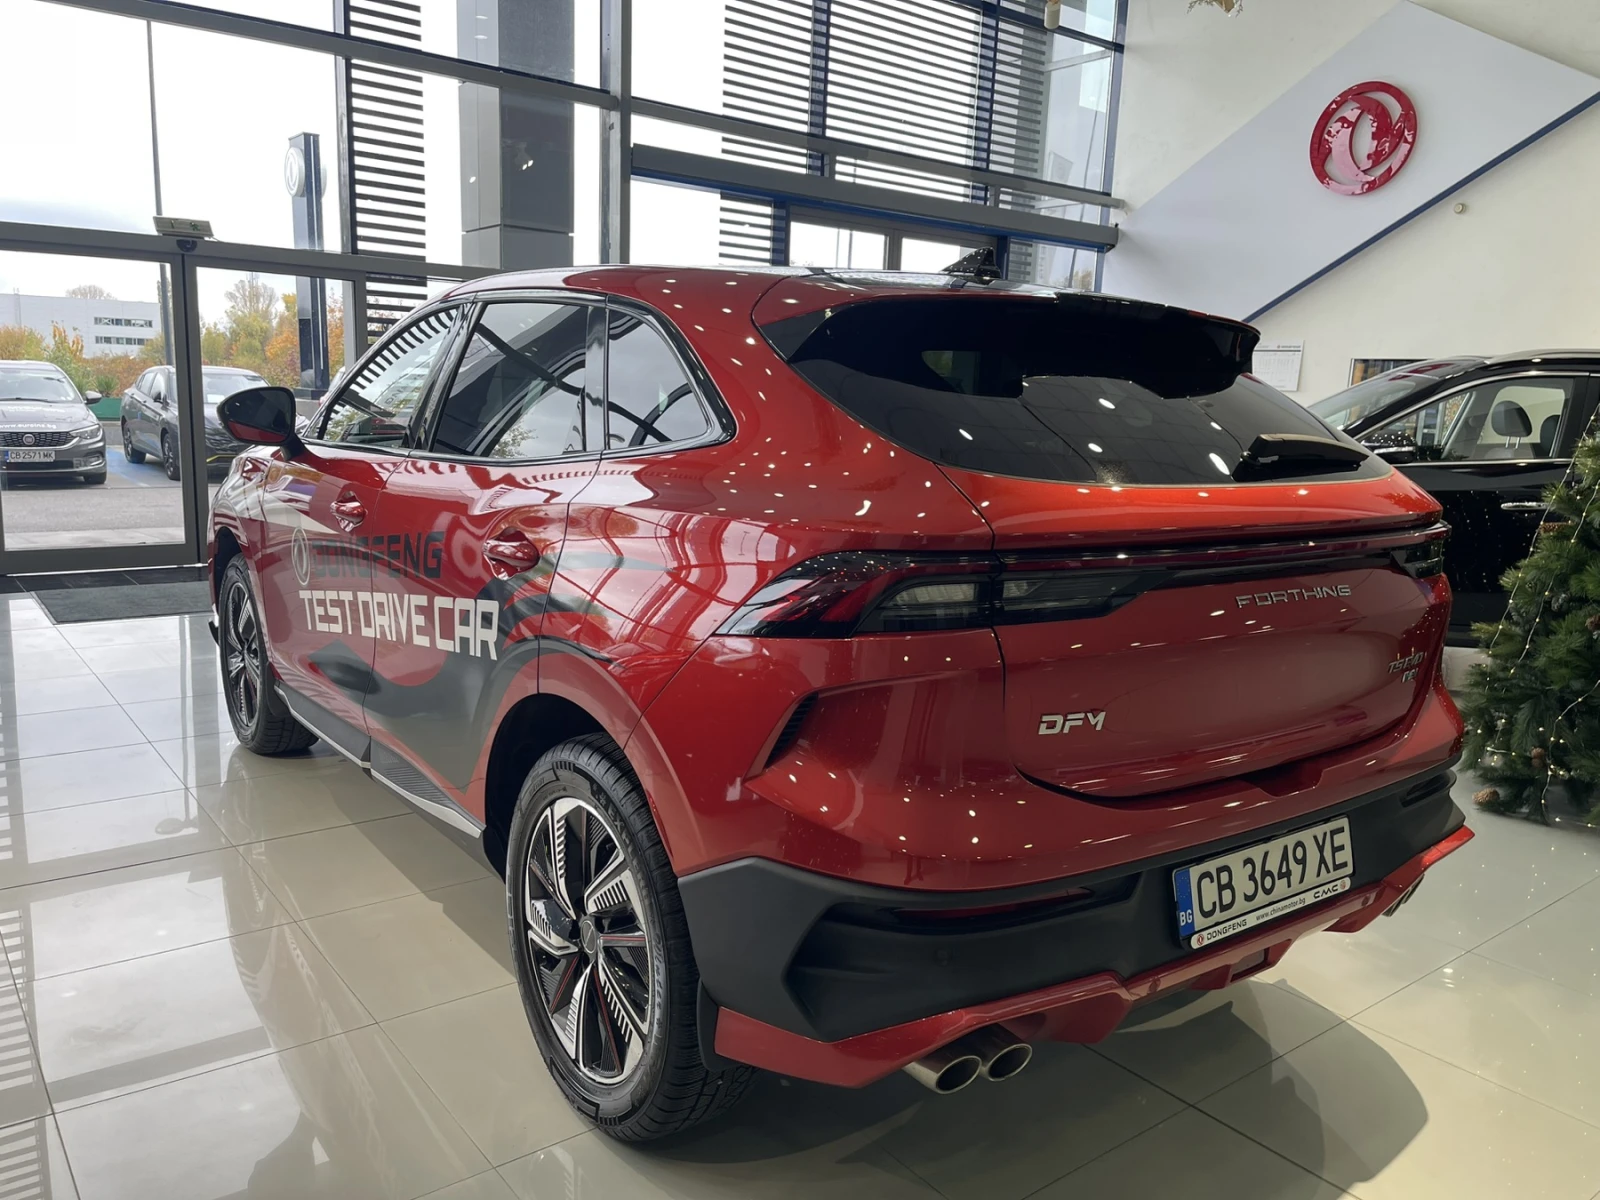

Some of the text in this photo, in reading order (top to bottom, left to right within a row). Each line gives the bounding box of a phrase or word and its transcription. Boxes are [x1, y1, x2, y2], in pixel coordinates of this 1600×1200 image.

[10, 451, 54, 460] CB 2571 MK
[312, 531, 444, 578] DONGFENG
[1236, 585, 1351, 608] FORTHING
[299, 590, 499, 661] TEST DRIVE CAR
[1197, 826, 1348, 919] CB 3649 XE
[1179, 911, 1193, 926] BG
[1206, 884, 1339, 941] DONGFENG www.chinamotor.bg CMC
